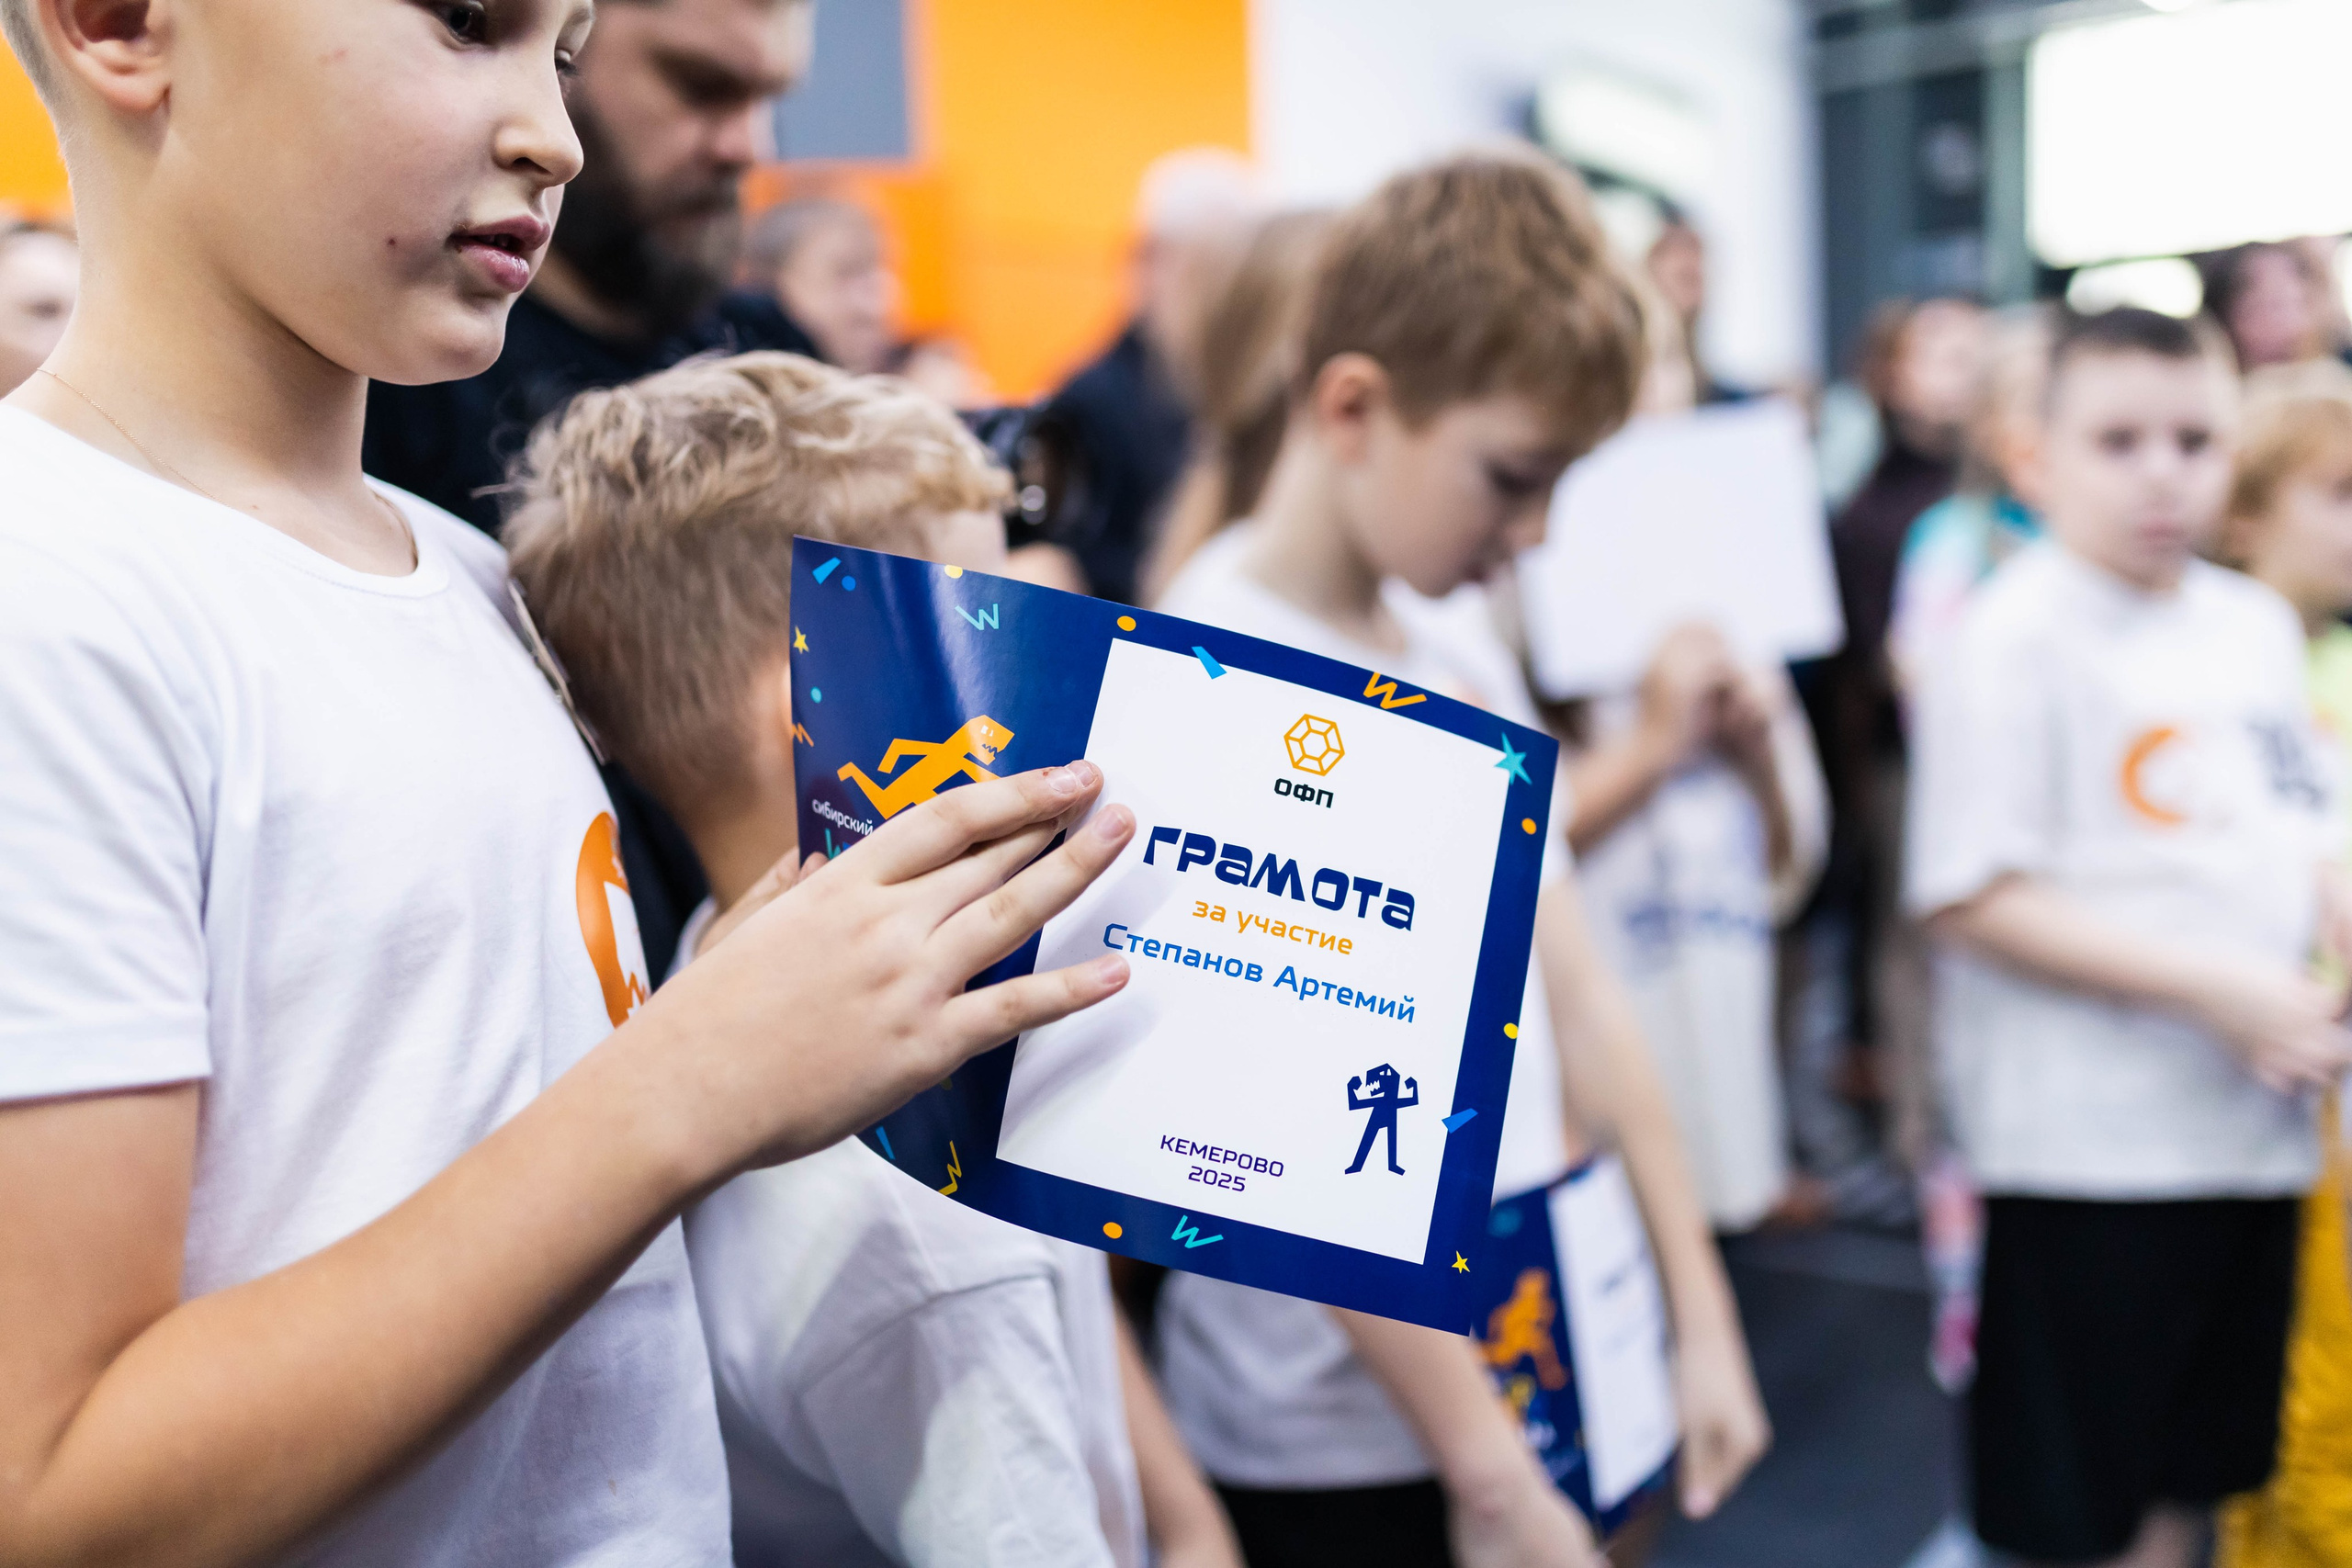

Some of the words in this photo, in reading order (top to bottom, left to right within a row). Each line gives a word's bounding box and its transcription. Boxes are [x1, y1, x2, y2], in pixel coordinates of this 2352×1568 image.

[1273, 778, 1334, 809] ОФП
[812, 798, 873, 836] сибирский
[1192, 900, 1227, 923] за
[1237, 910, 1353, 955] участие
[1102, 922, 1263, 983] Степанов
[1272, 964, 1416, 1024] Артемий
[1159, 1134, 1284, 1178] КЕМЕРОВО
[1188, 1165, 1247, 1192] 2025
